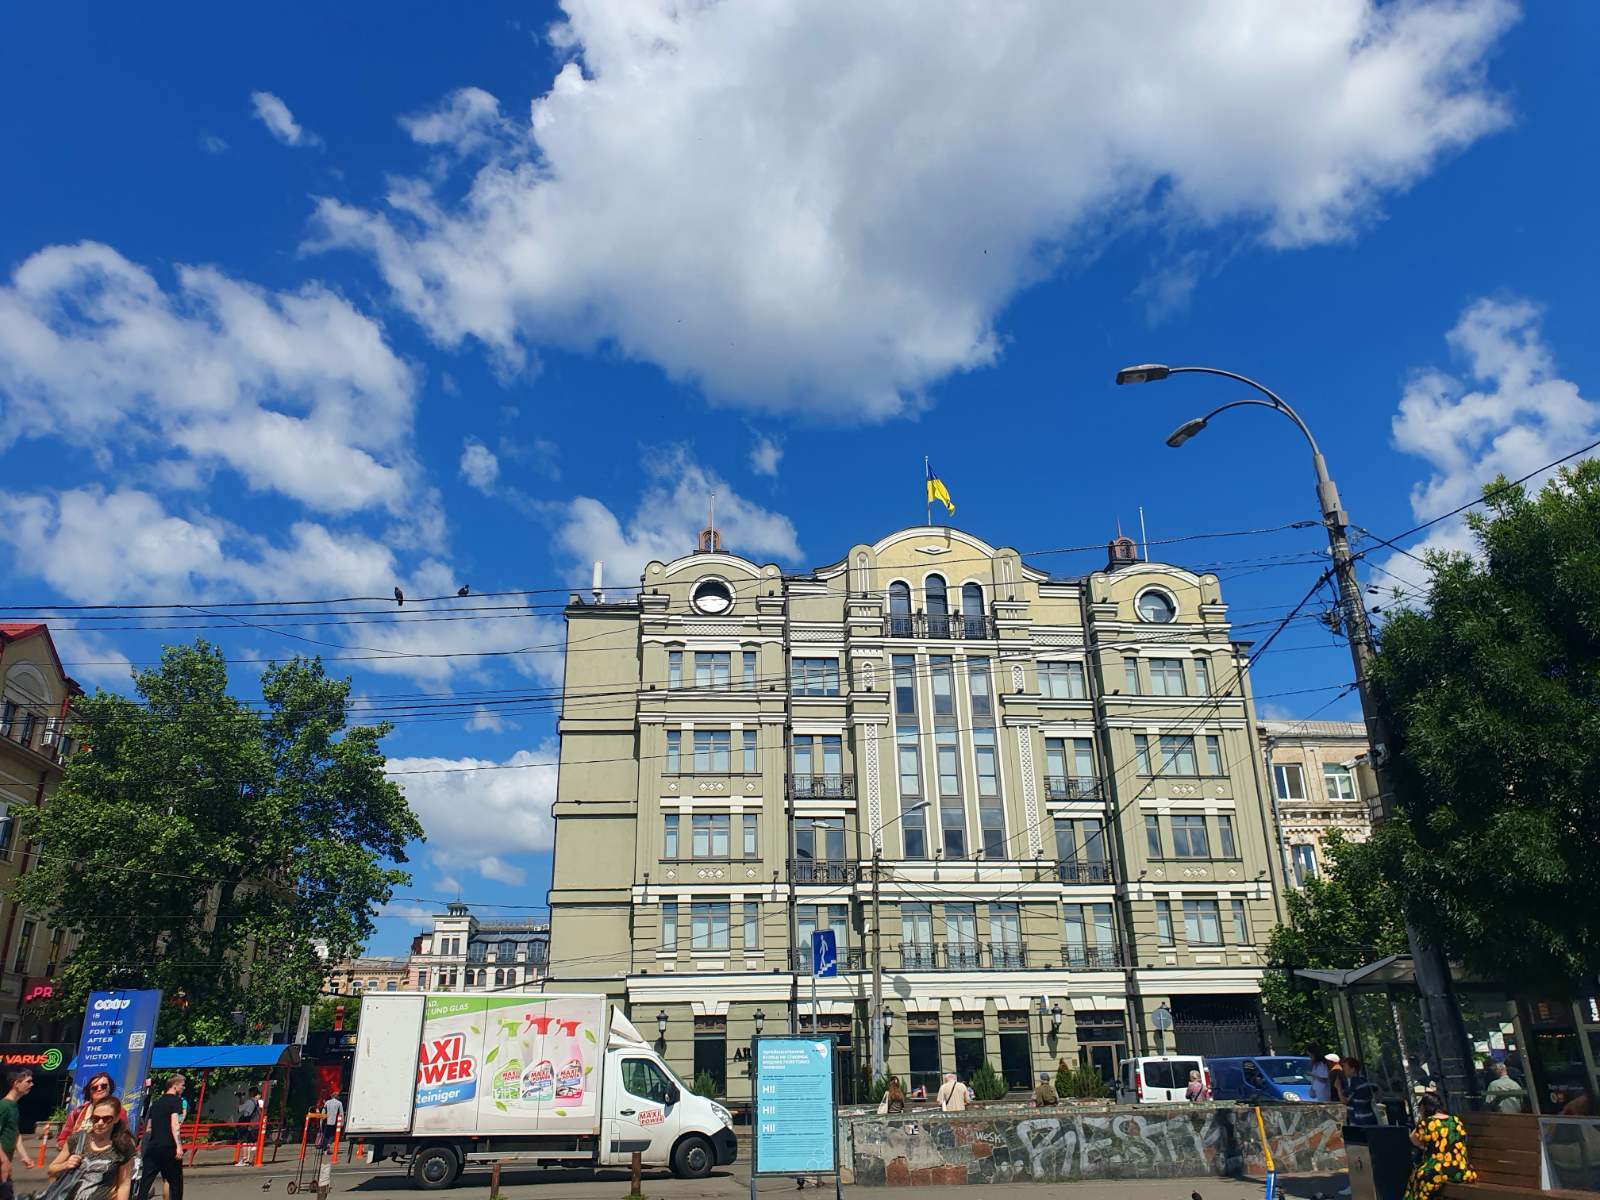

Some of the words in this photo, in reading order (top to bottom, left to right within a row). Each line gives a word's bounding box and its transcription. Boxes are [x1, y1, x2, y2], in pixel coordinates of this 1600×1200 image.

[449, 1003, 469, 1012] GLAS
[5, 1054, 49, 1065] VARUS
[640, 1110, 660, 1119] MAXI
